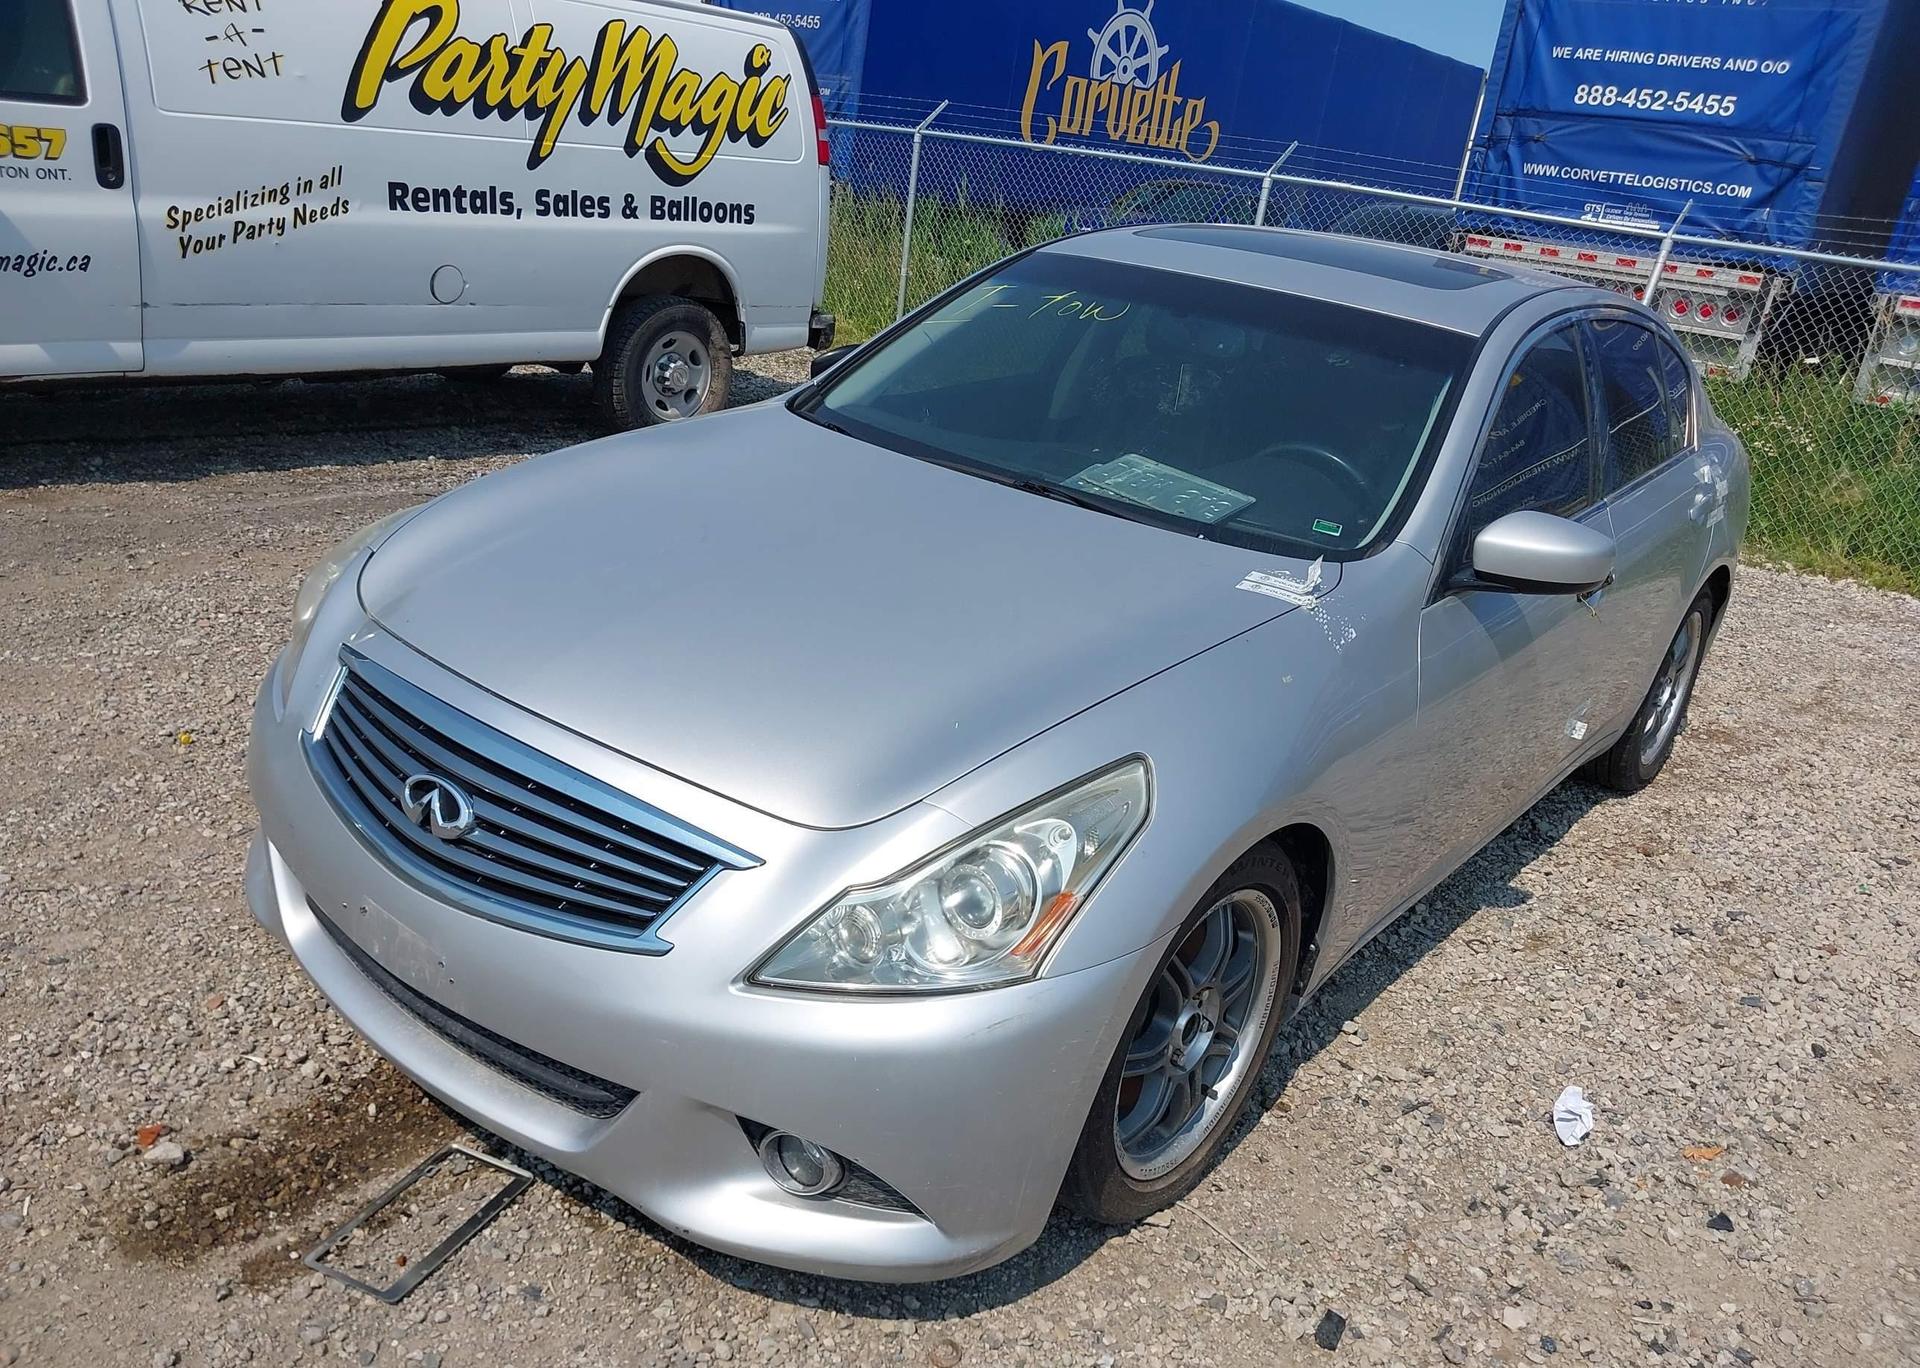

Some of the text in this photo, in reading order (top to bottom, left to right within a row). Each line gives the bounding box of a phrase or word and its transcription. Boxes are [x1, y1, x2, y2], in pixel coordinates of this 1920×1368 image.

[1552, 46, 1573, 59] WE
[1573, 48, 1603, 61] ARE
[1604, 50, 1655, 65] HIRING
[1657, 53, 1722, 71] DRIVERS
[1723, 58, 1758, 73] AND
[1021, 38, 1220, 163] Corvette
[1573, 84, 1738, 117] 888-452-5455
[35, 167, 73, 181] ONT.
[1523, 162, 1753, 199] WWW.CORVETTELOGISTICS.COM
[166, 165, 343, 232] Specializing in all
[387, 181, 756, 225] Rentals, Sales & Balloons
[1583, 203, 1602, 213] GTS
[179, 196, 350, 259] Your Party Needs
